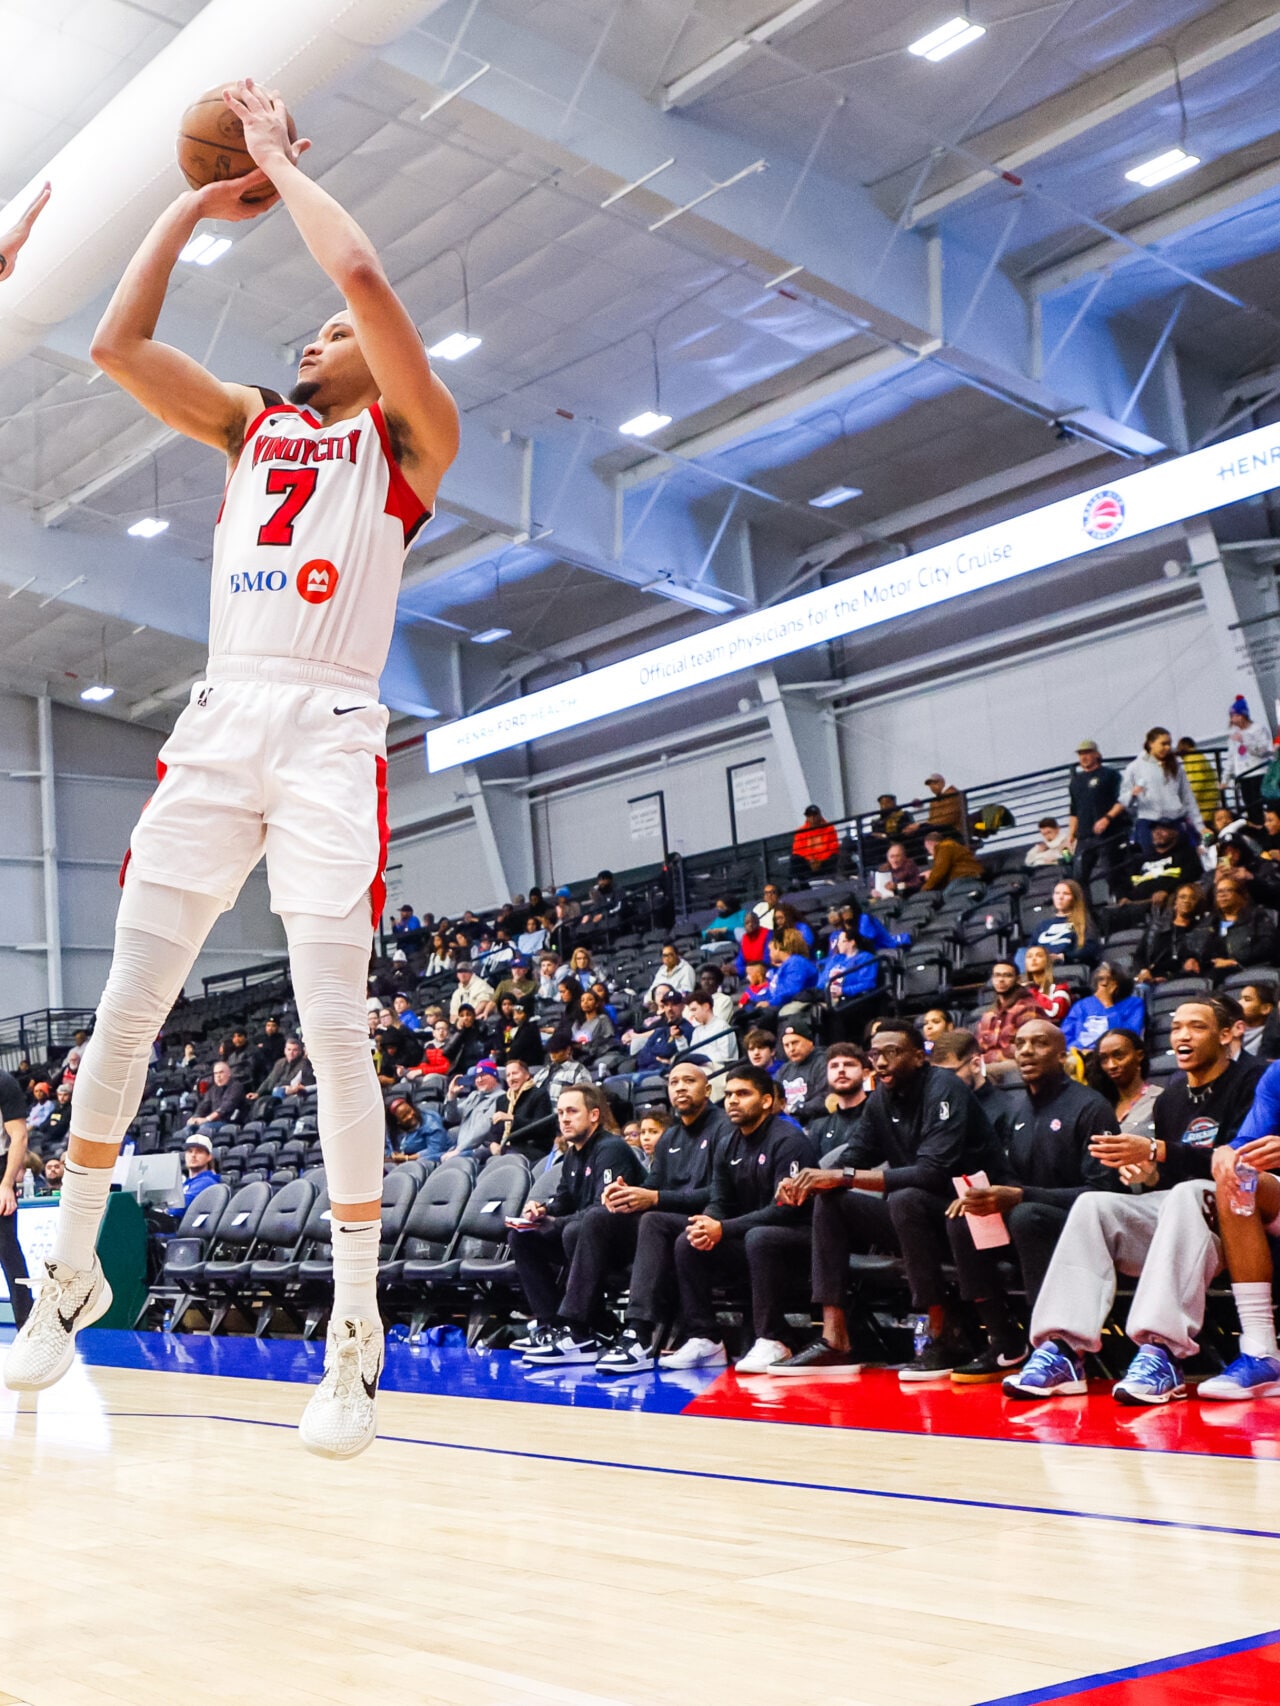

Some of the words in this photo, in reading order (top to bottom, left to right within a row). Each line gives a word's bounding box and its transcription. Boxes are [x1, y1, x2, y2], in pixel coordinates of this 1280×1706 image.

[257, 468, 319, 546] 7
[230, 570, 288, 594] BMO
[639, 654, 688, 686] Official
[690, 645, 727, 668] team
[728, 619, 805, 661] physicians
[807, 607, 830, 627] for
[833, 597, 860, 618] the
[863, 578, 912, 608] Motor
[917, 564, 952, 588] City
[956, 543, 1013, 575] Cruise
